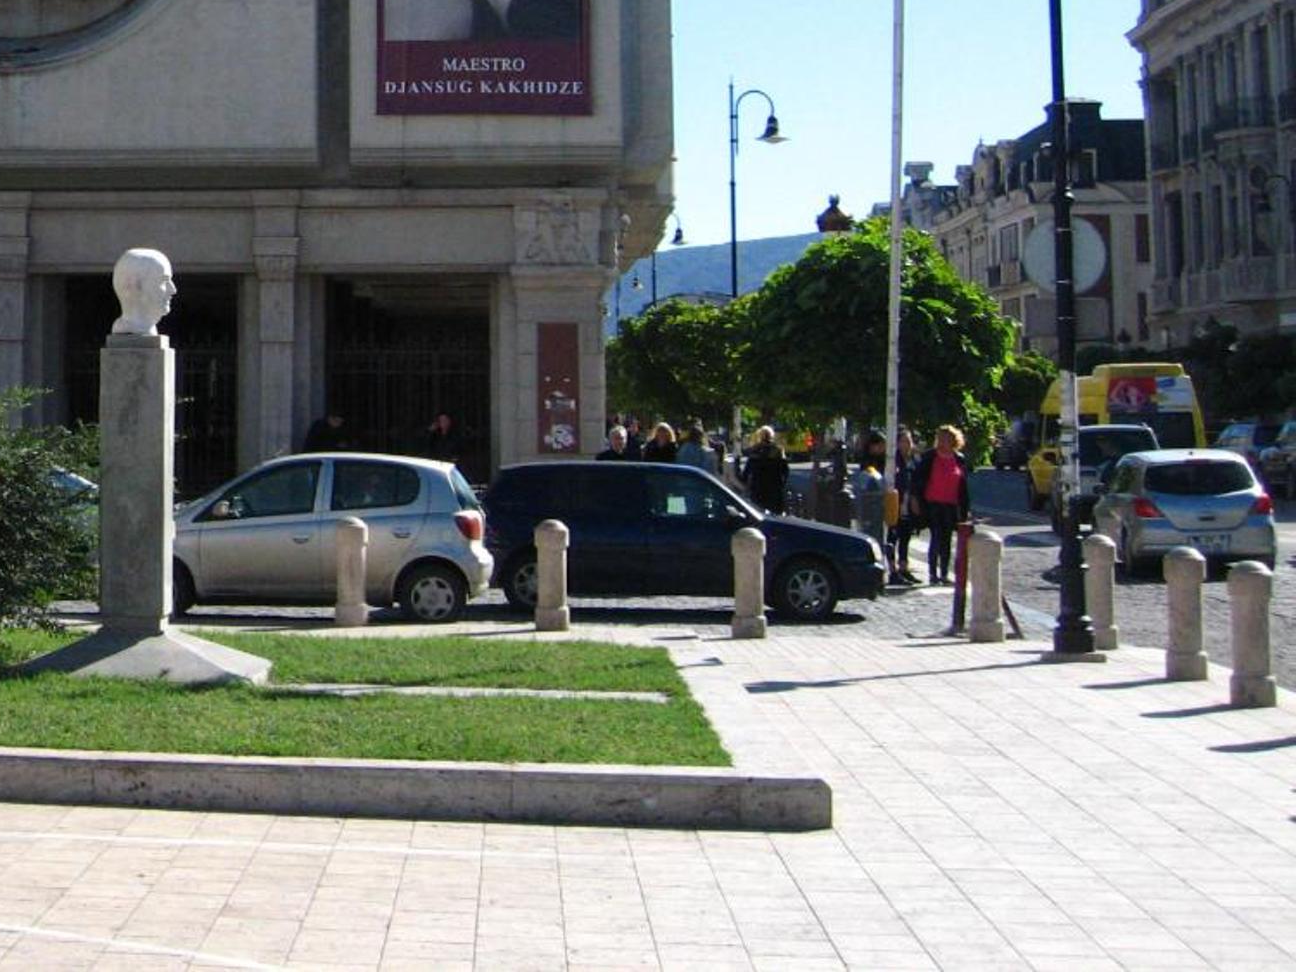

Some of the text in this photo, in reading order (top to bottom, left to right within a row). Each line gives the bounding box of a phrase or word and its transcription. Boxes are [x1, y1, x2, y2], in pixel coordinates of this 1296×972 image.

[443, 57, 525, 71] MAESTRO
[384, 80, 584, 95] DJANSUG KAKHIDZE
